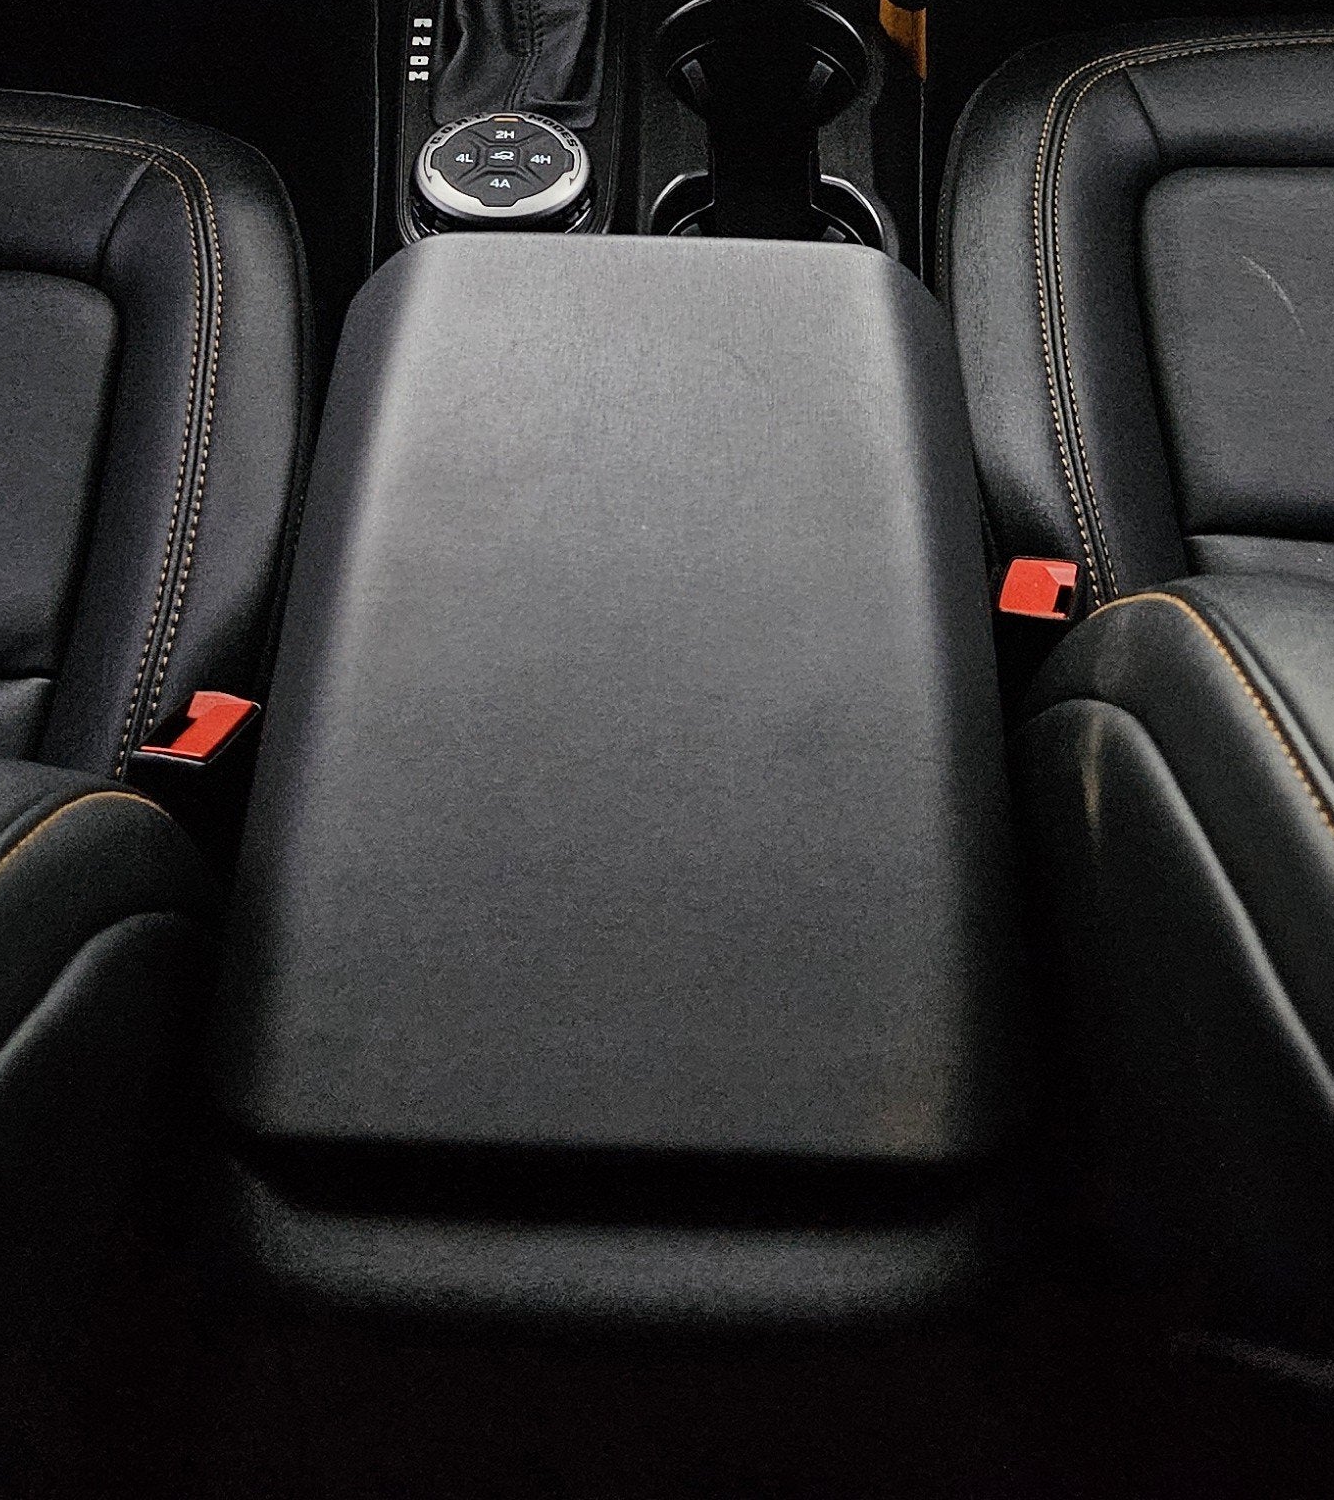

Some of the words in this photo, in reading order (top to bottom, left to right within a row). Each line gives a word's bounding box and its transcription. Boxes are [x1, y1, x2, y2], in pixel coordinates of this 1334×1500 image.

[413, 18, 433, 28] R
[412, 36, 431, 46] N
[408, 71, 429, 81] M
[495, 129, 515, 140] 2H
[528, 113, 580, 149] MODES
[455, 153, 475, 164] 4L
[530, 154, 551, 165] 4H
[489, 178, 512, 189] 4A
